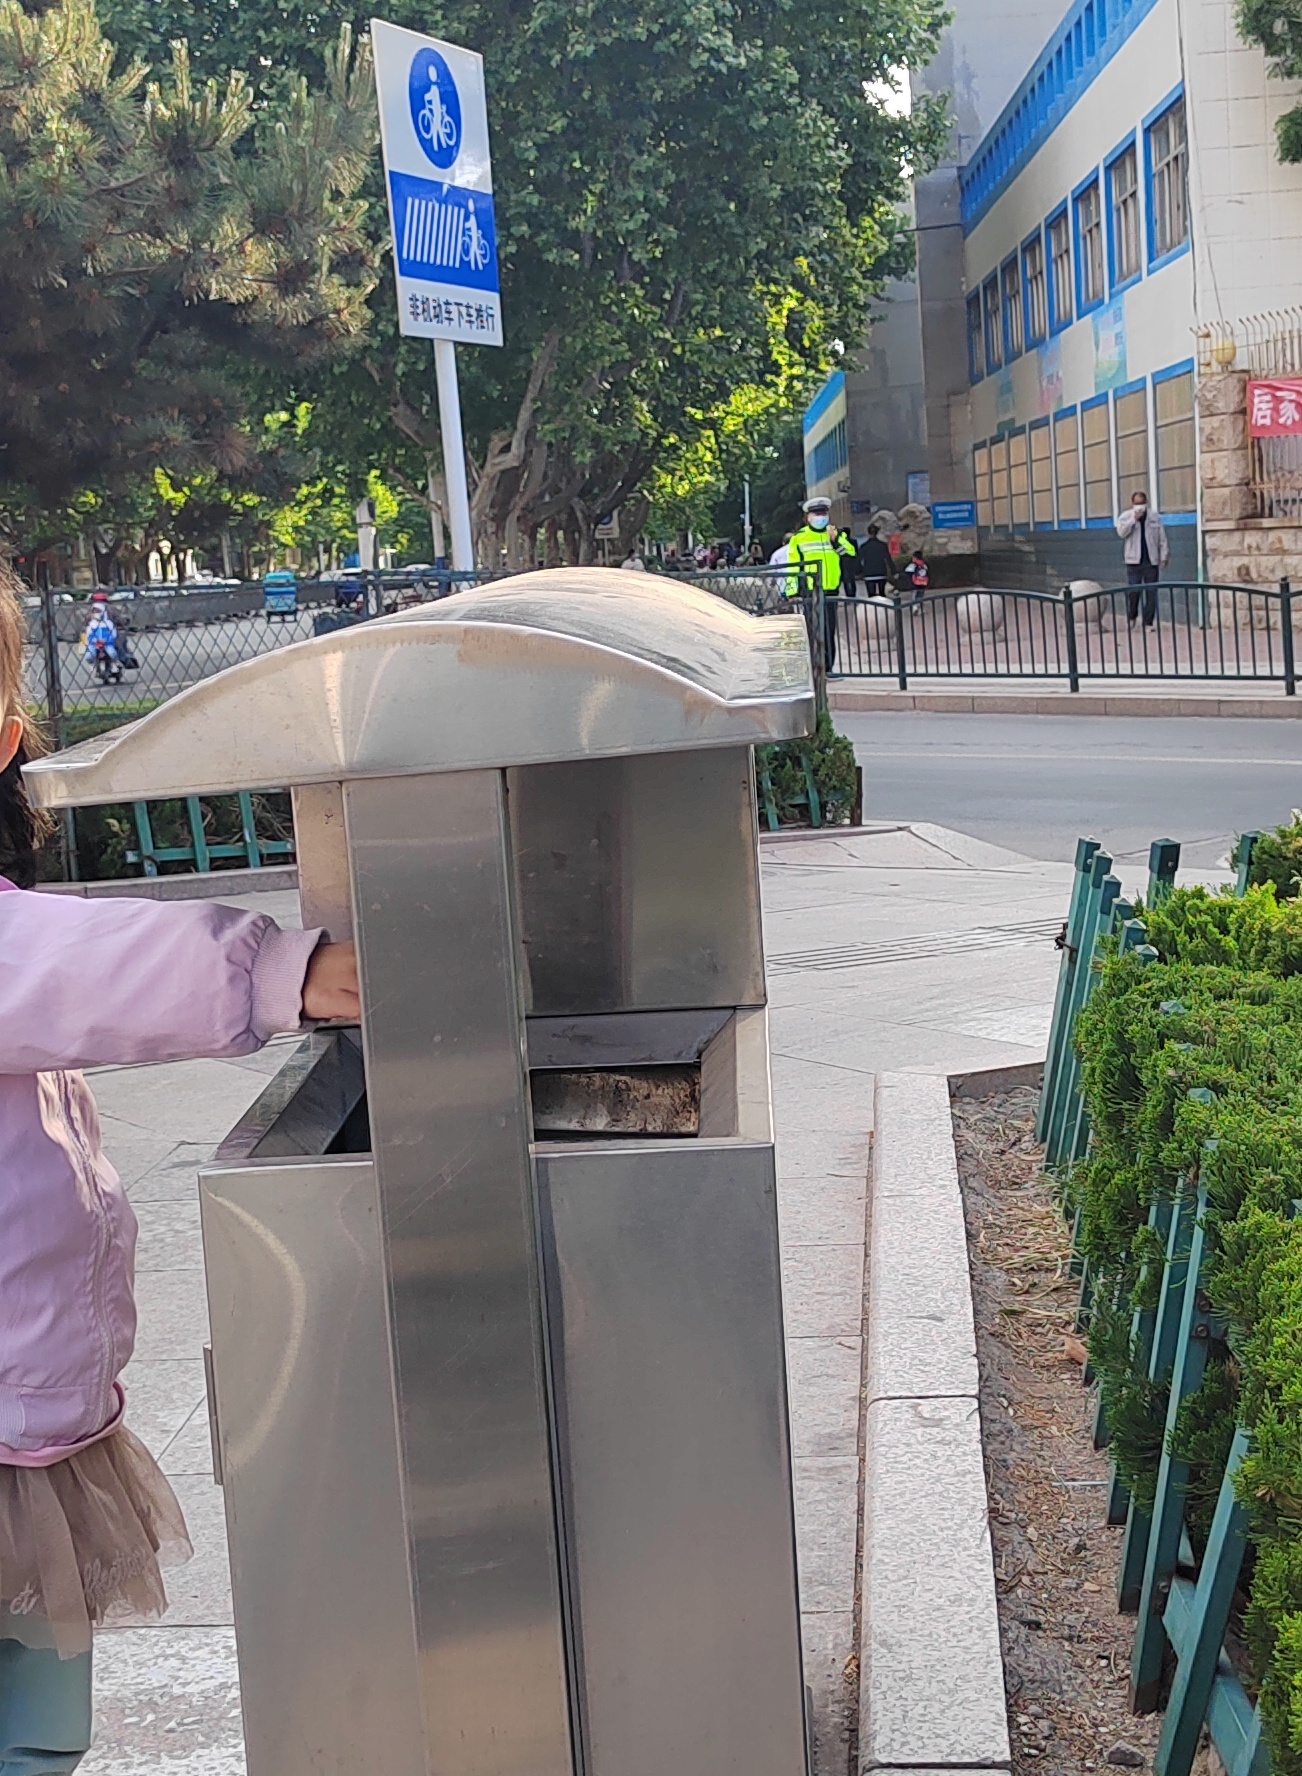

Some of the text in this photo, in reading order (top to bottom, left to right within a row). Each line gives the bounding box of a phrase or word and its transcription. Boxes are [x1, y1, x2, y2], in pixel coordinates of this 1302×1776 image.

[408, 292, 496, 333] 非机动车下车推行
